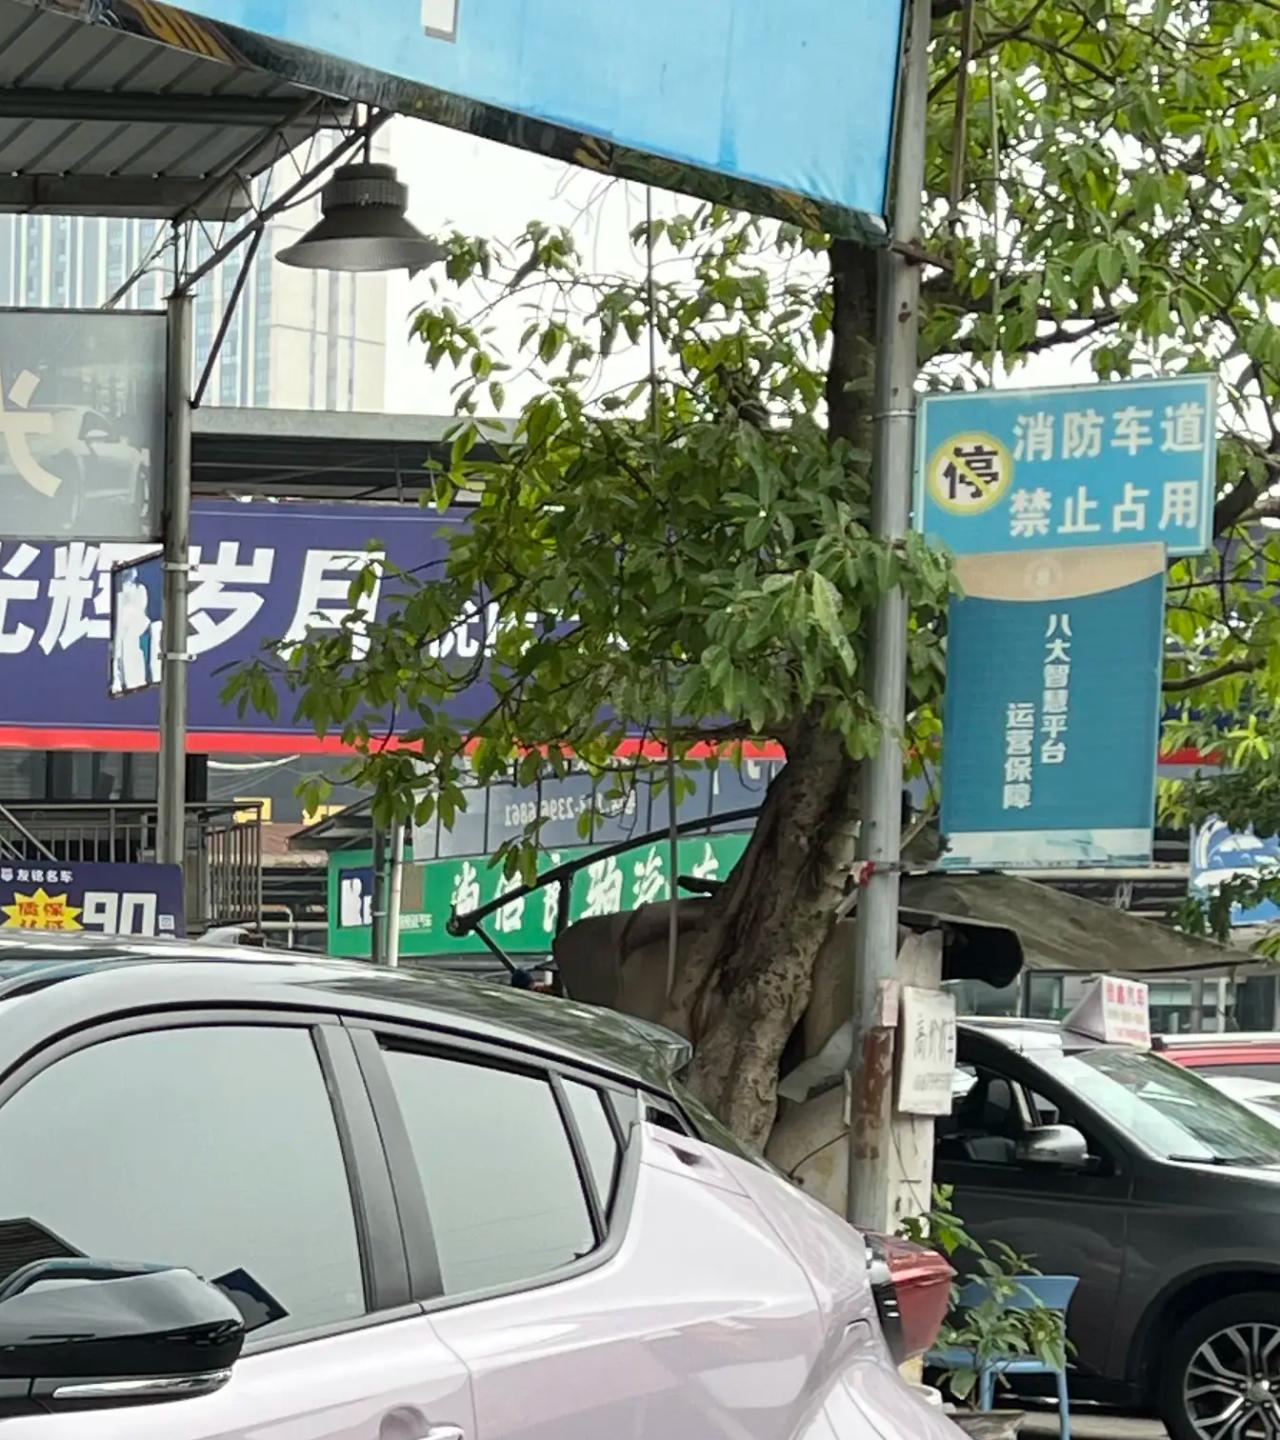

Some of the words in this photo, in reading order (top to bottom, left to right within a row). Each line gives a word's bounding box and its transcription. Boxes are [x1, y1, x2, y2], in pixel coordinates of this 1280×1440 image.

[1011, 401, 1206, 463] 消防车道
[942, 444, 1001, 501] 停
[1008, 480, 1201, 539] 禁止占用
[1040, 612, 1074, 766] 八大智慧平台
[1002, 701, 1037, 811] 运营保障
[81, 891, 158, 937] 90
